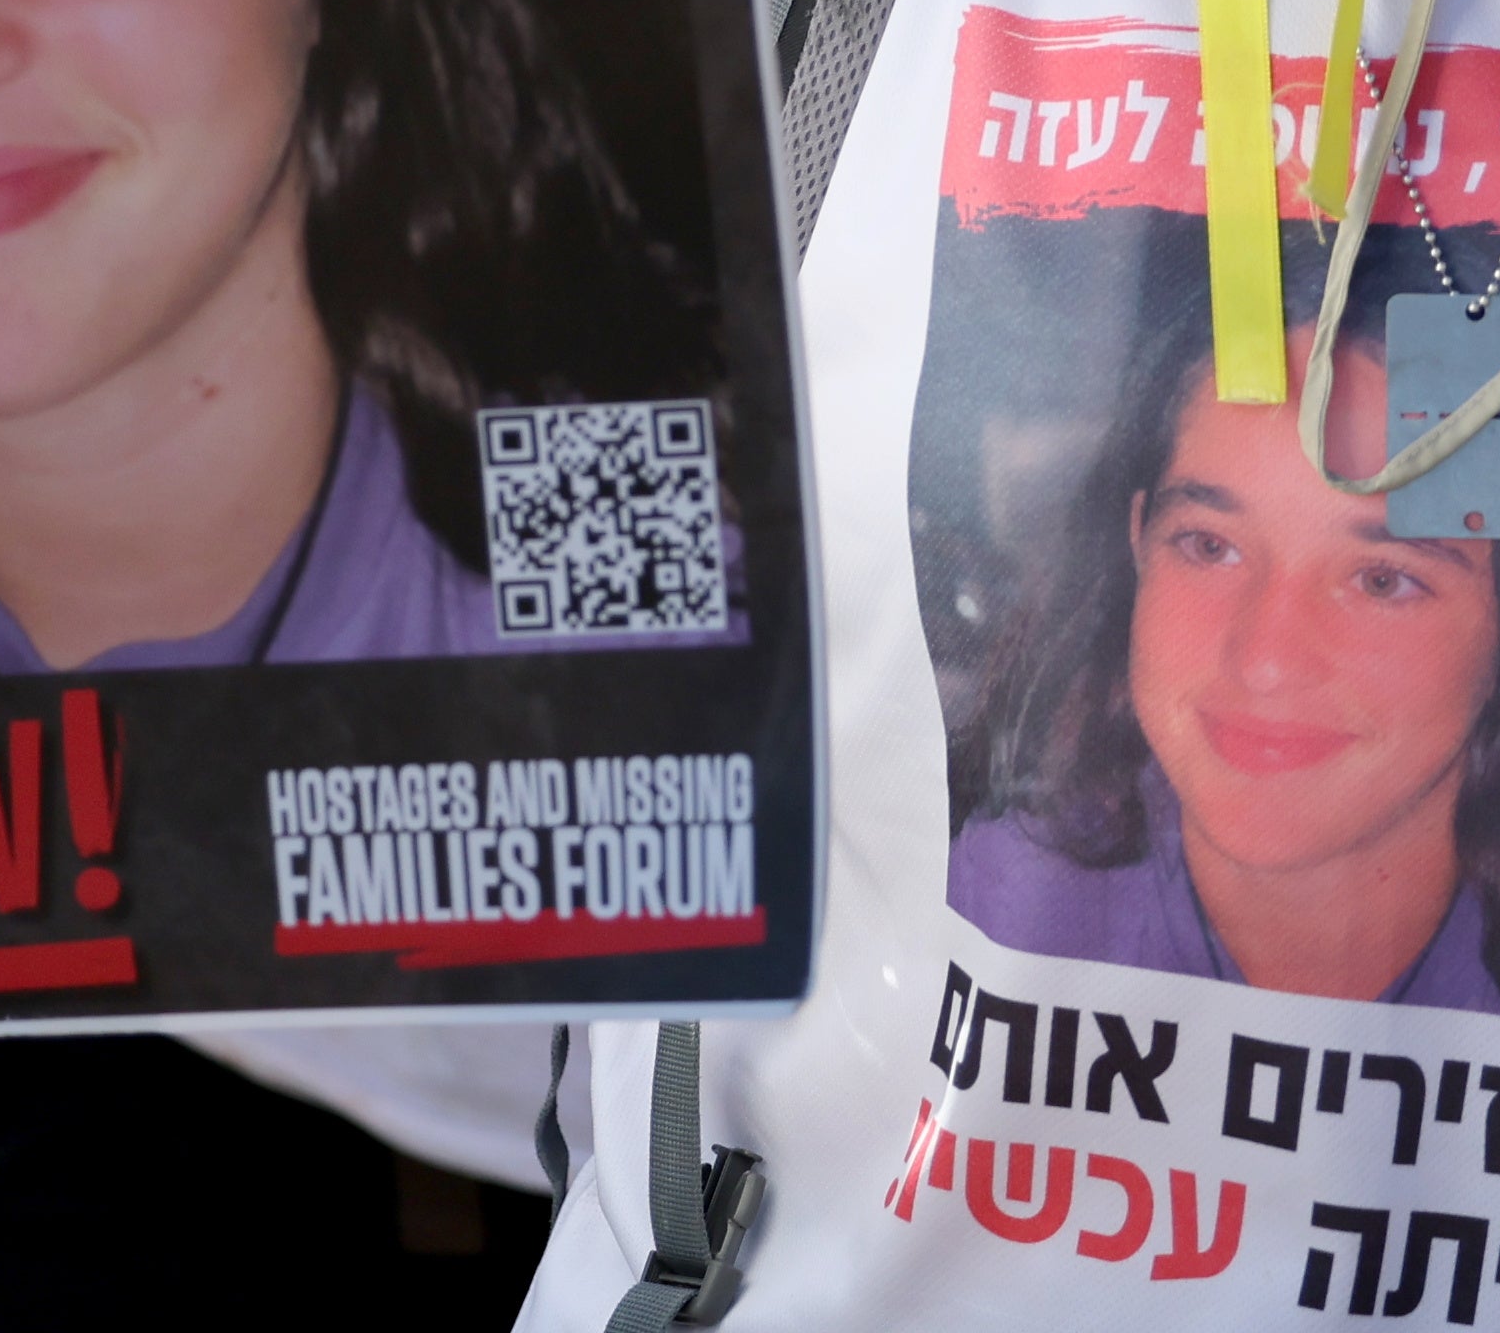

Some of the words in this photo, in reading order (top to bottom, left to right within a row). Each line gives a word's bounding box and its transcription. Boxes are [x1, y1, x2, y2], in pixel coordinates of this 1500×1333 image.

[978, 79, 1170, 171] לעזה
[267, 761, 479, 835] HOSTAGES
[486, 759, 569, 829] AND
[574, 753, 755, 825] MISSING
[274, 828, 542, 928] FAMILIES
[553, 824, 756, 920] FORUM
